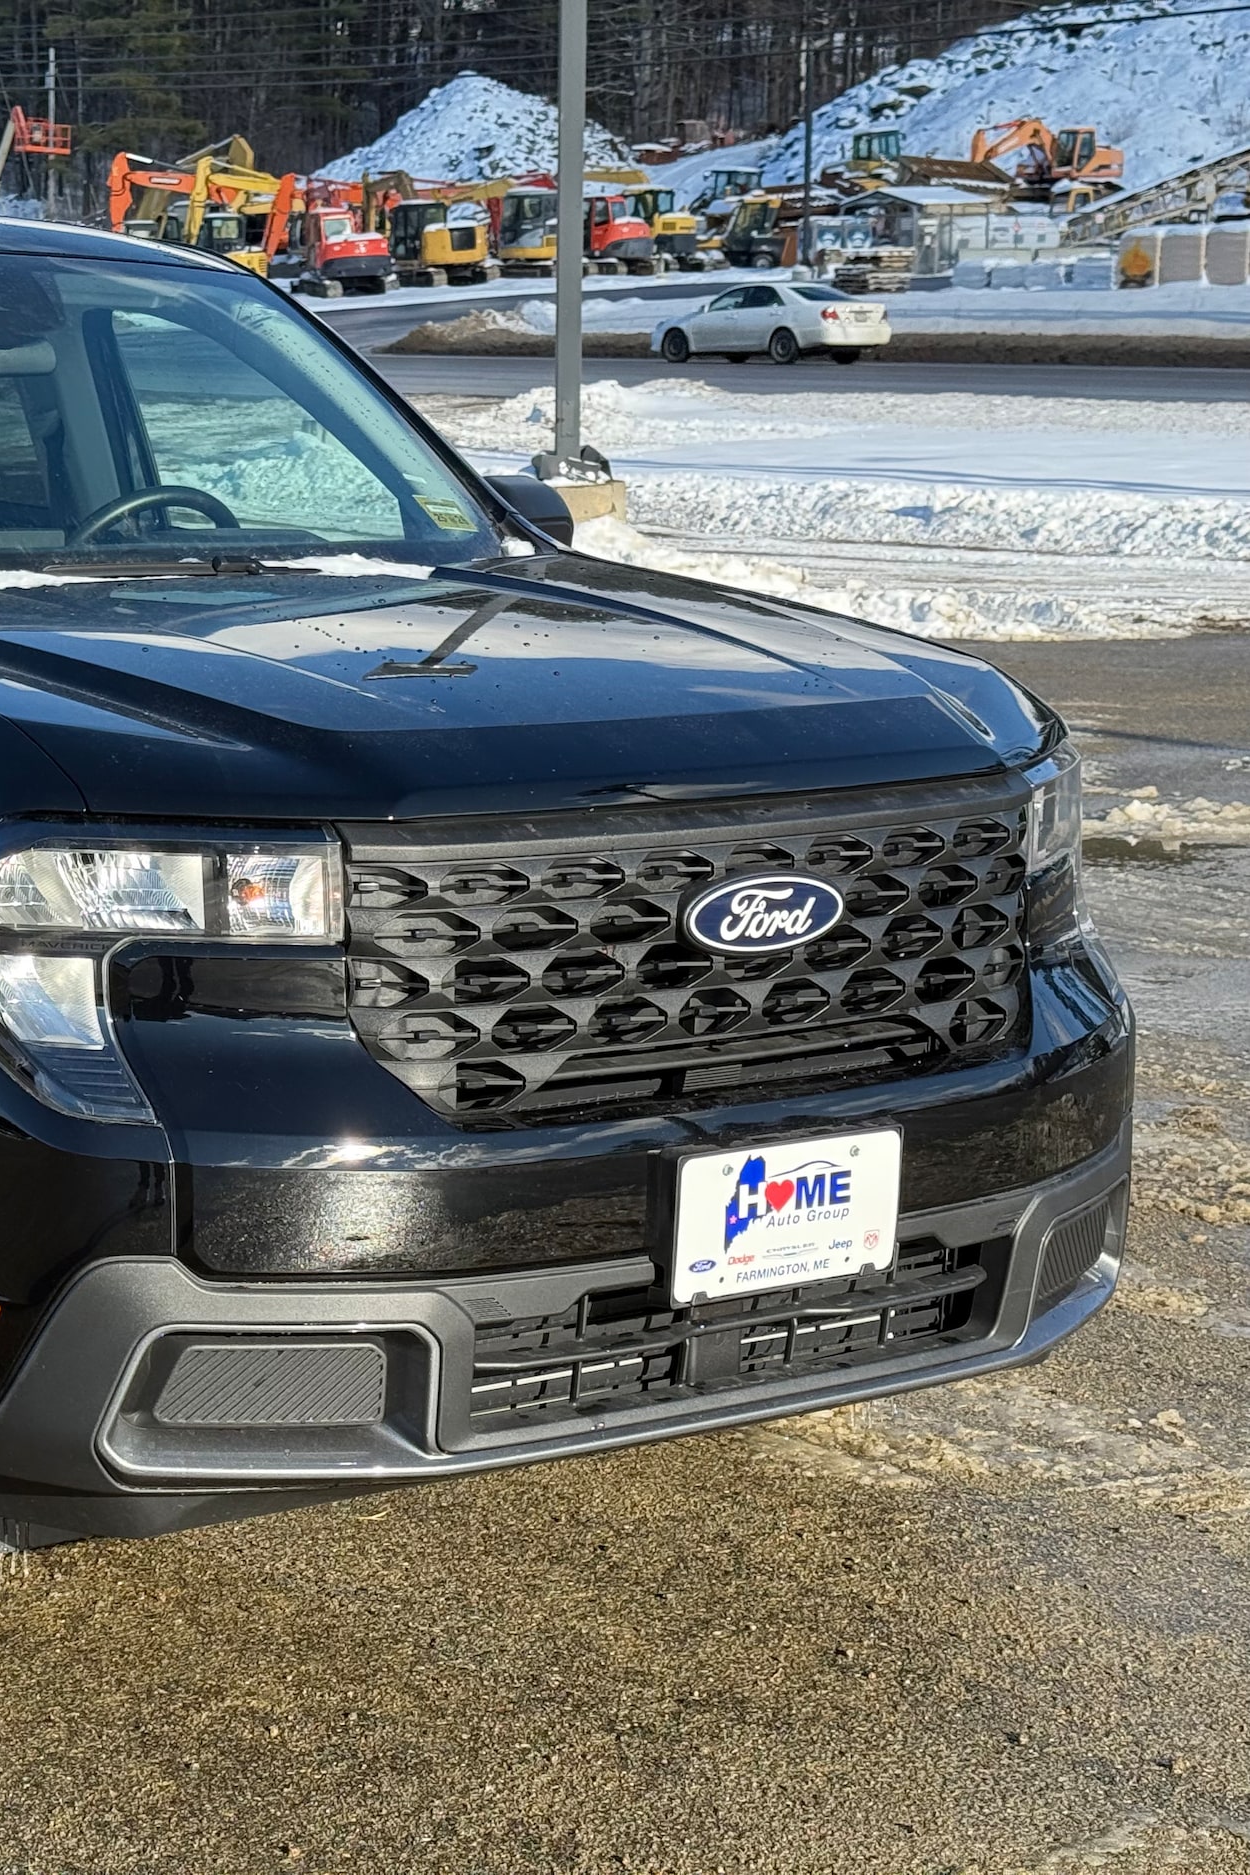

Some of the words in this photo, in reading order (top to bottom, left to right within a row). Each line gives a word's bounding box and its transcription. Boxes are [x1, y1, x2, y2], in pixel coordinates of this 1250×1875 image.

[720, 888, 816, 941] Ford
[766, 1213, 800, 1228] Auto
[806, 1207, 850, 1222] Group
[692, 1261, 712, 1271] Ford
[727, 1253, 755, 1266] Dodge
[828, 1239, 853, 1250] Jeep
[736, 1261, 810, 1283] FARMINGTON,
[813, 1258, 830, 1269] ME
